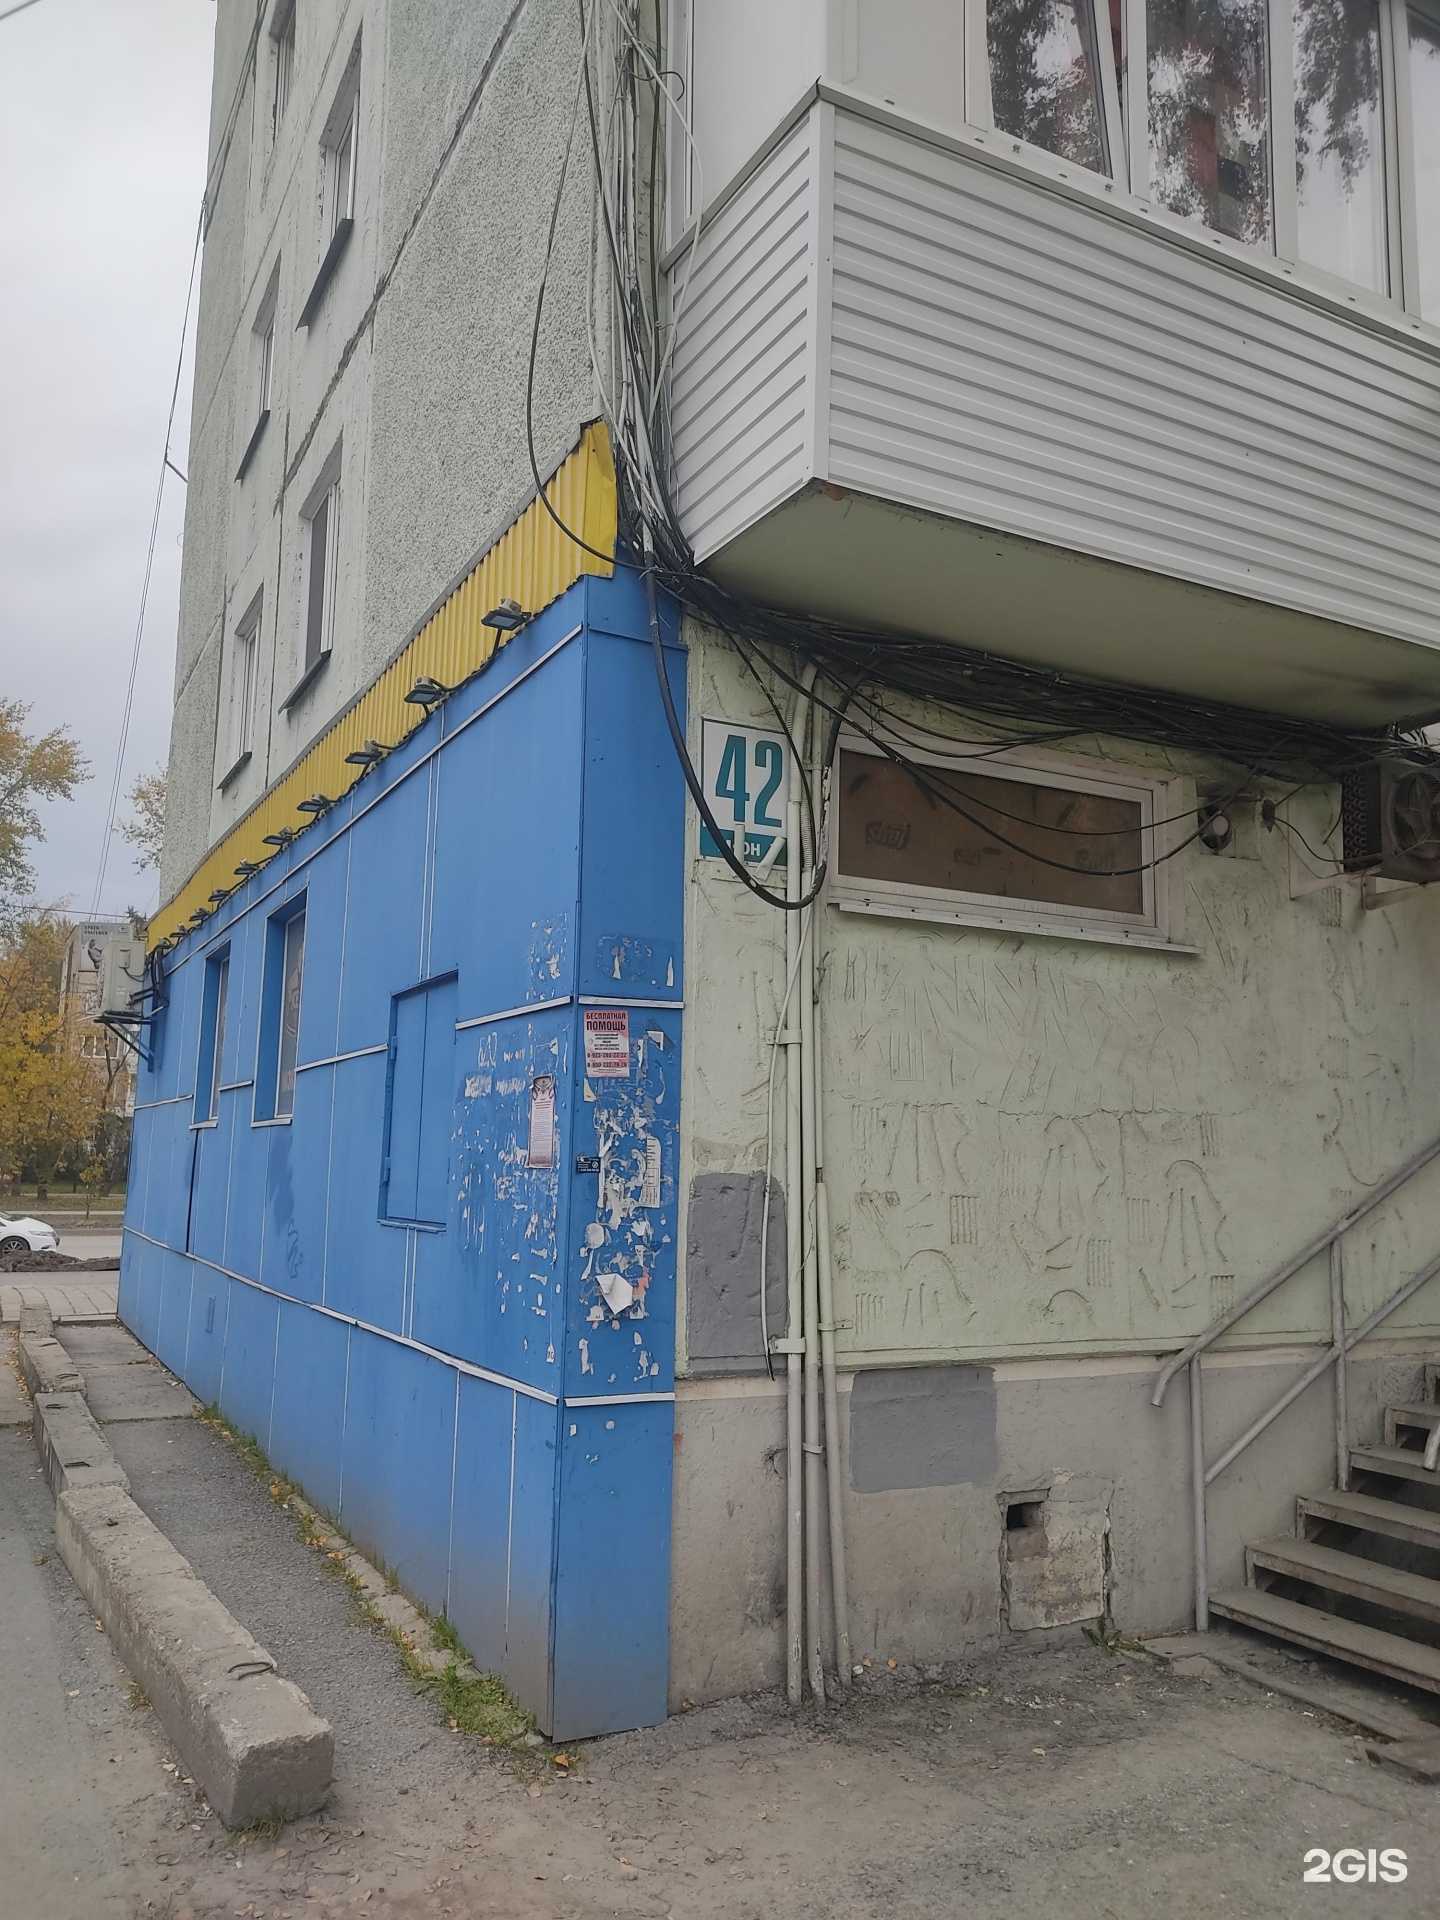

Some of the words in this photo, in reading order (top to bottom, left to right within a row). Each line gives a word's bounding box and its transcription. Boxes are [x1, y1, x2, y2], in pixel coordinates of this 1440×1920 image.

[715, 734, 782, 828] 42
[586, 1012, 626, 1020] БЕСПЛАТНАЯ
[586, 1021, 626, 1031] ПОМОЩЬ
